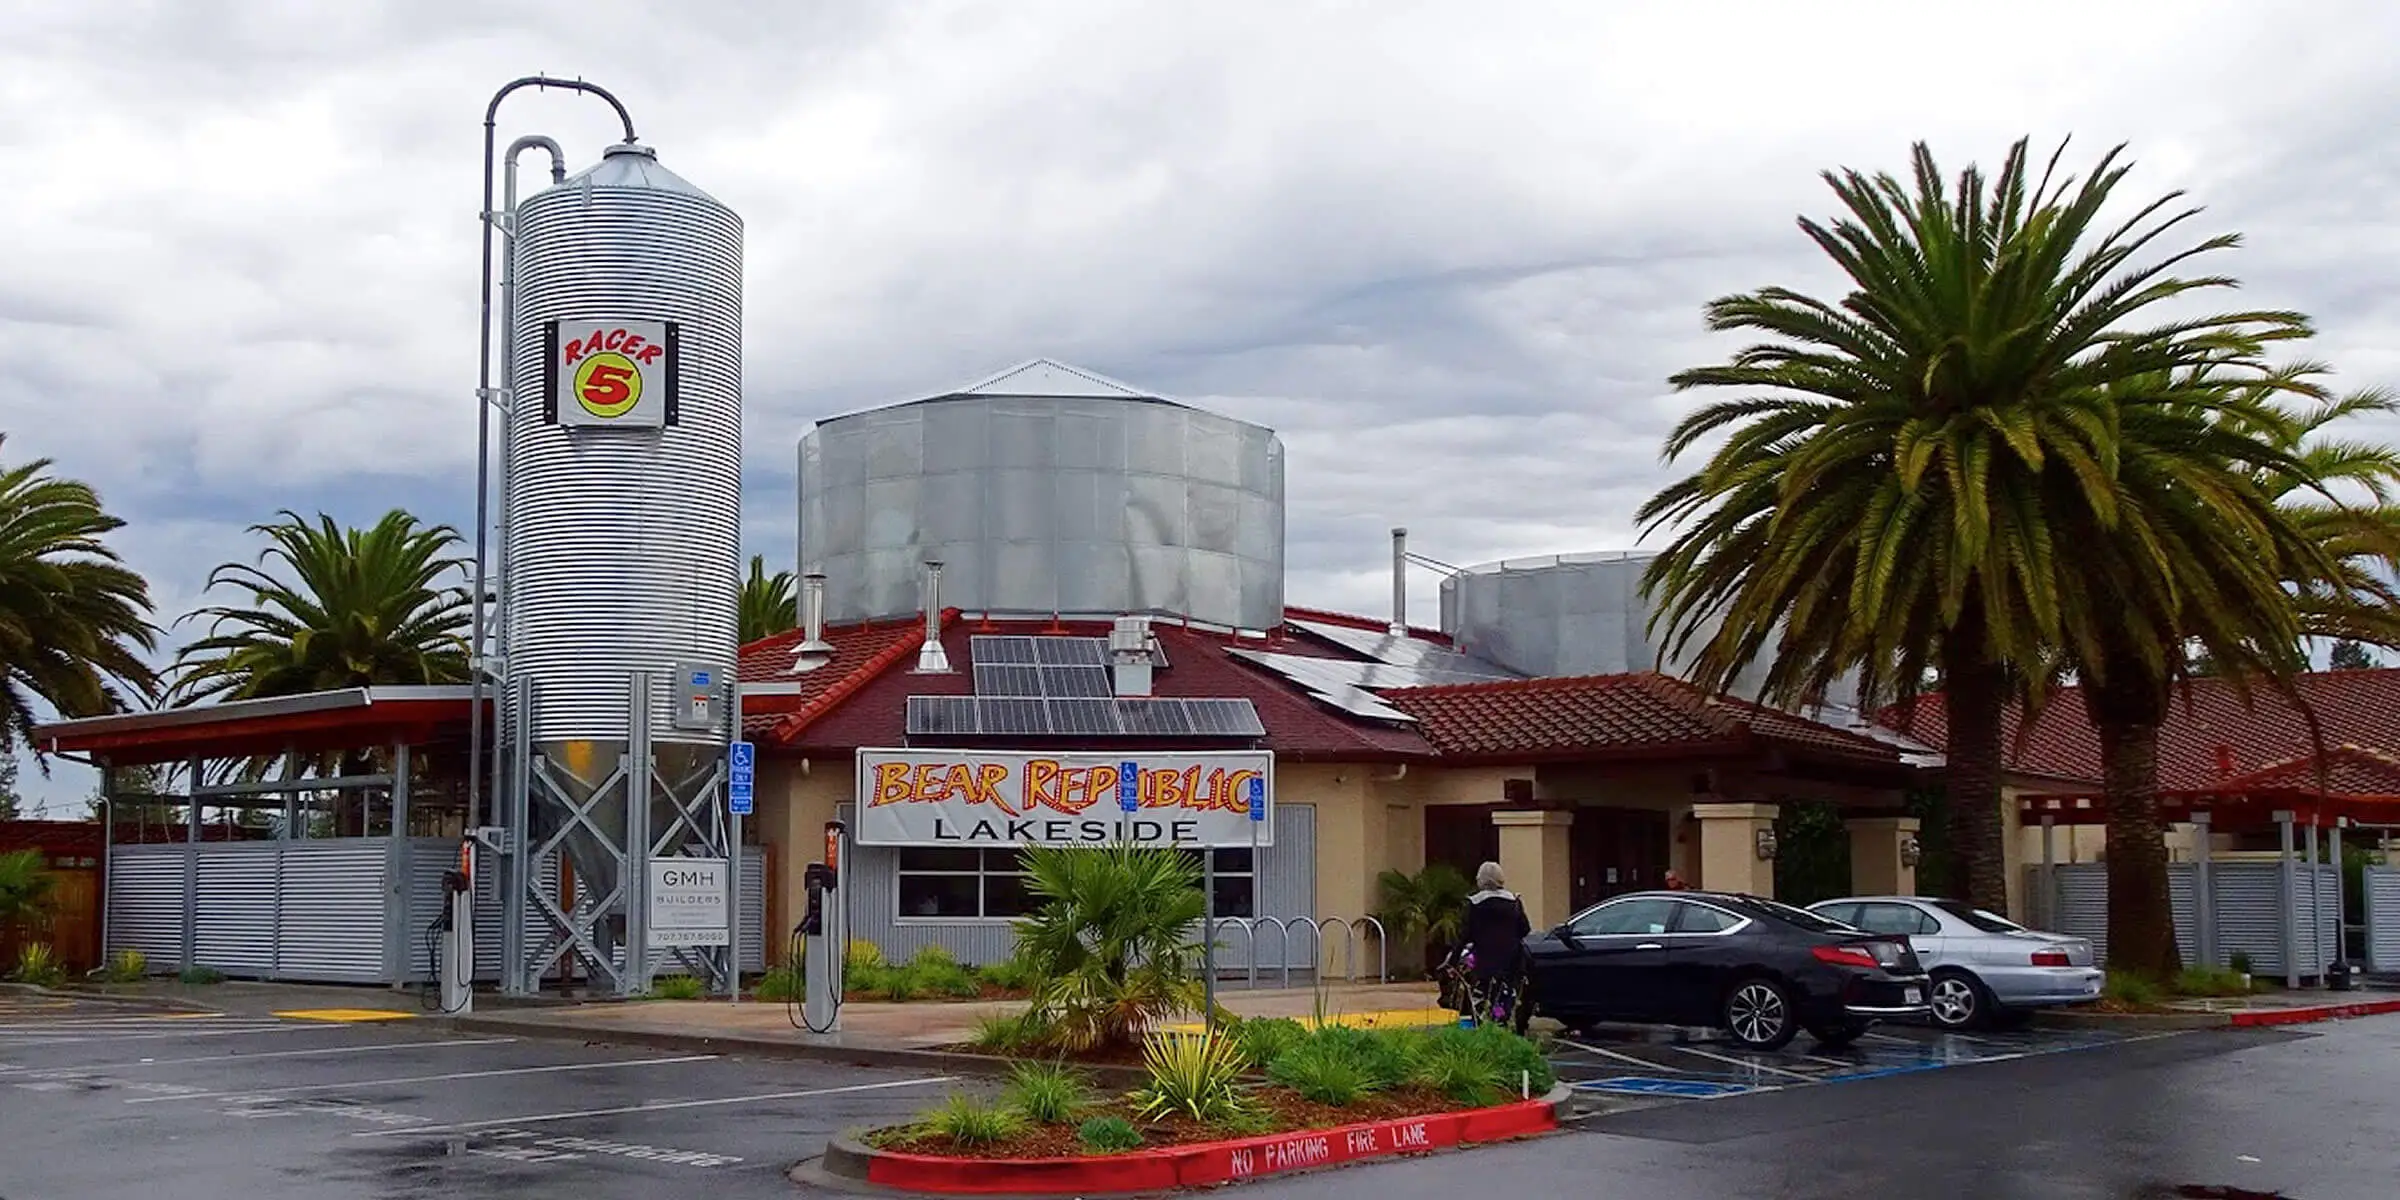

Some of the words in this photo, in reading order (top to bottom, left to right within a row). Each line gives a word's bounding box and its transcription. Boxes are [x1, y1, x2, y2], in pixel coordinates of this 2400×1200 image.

[564, 328, 664, 367] RACER
[582, 364, 635, 406] 5
[868, 762, 1020, 817] BEAR
[935, 818, 1198, 841] LAKESIDE
[663, 870, 714, 886] GMH
[656, 895, 721, 905] BUILDERS
[1231, 1149, 1253, 1175] NO
[1266, 1137, 1328, 1168] PARKING
[1347, 1129, 1378, 1153] FIRE
[1392, 1123, 1429, 1148] LANE
